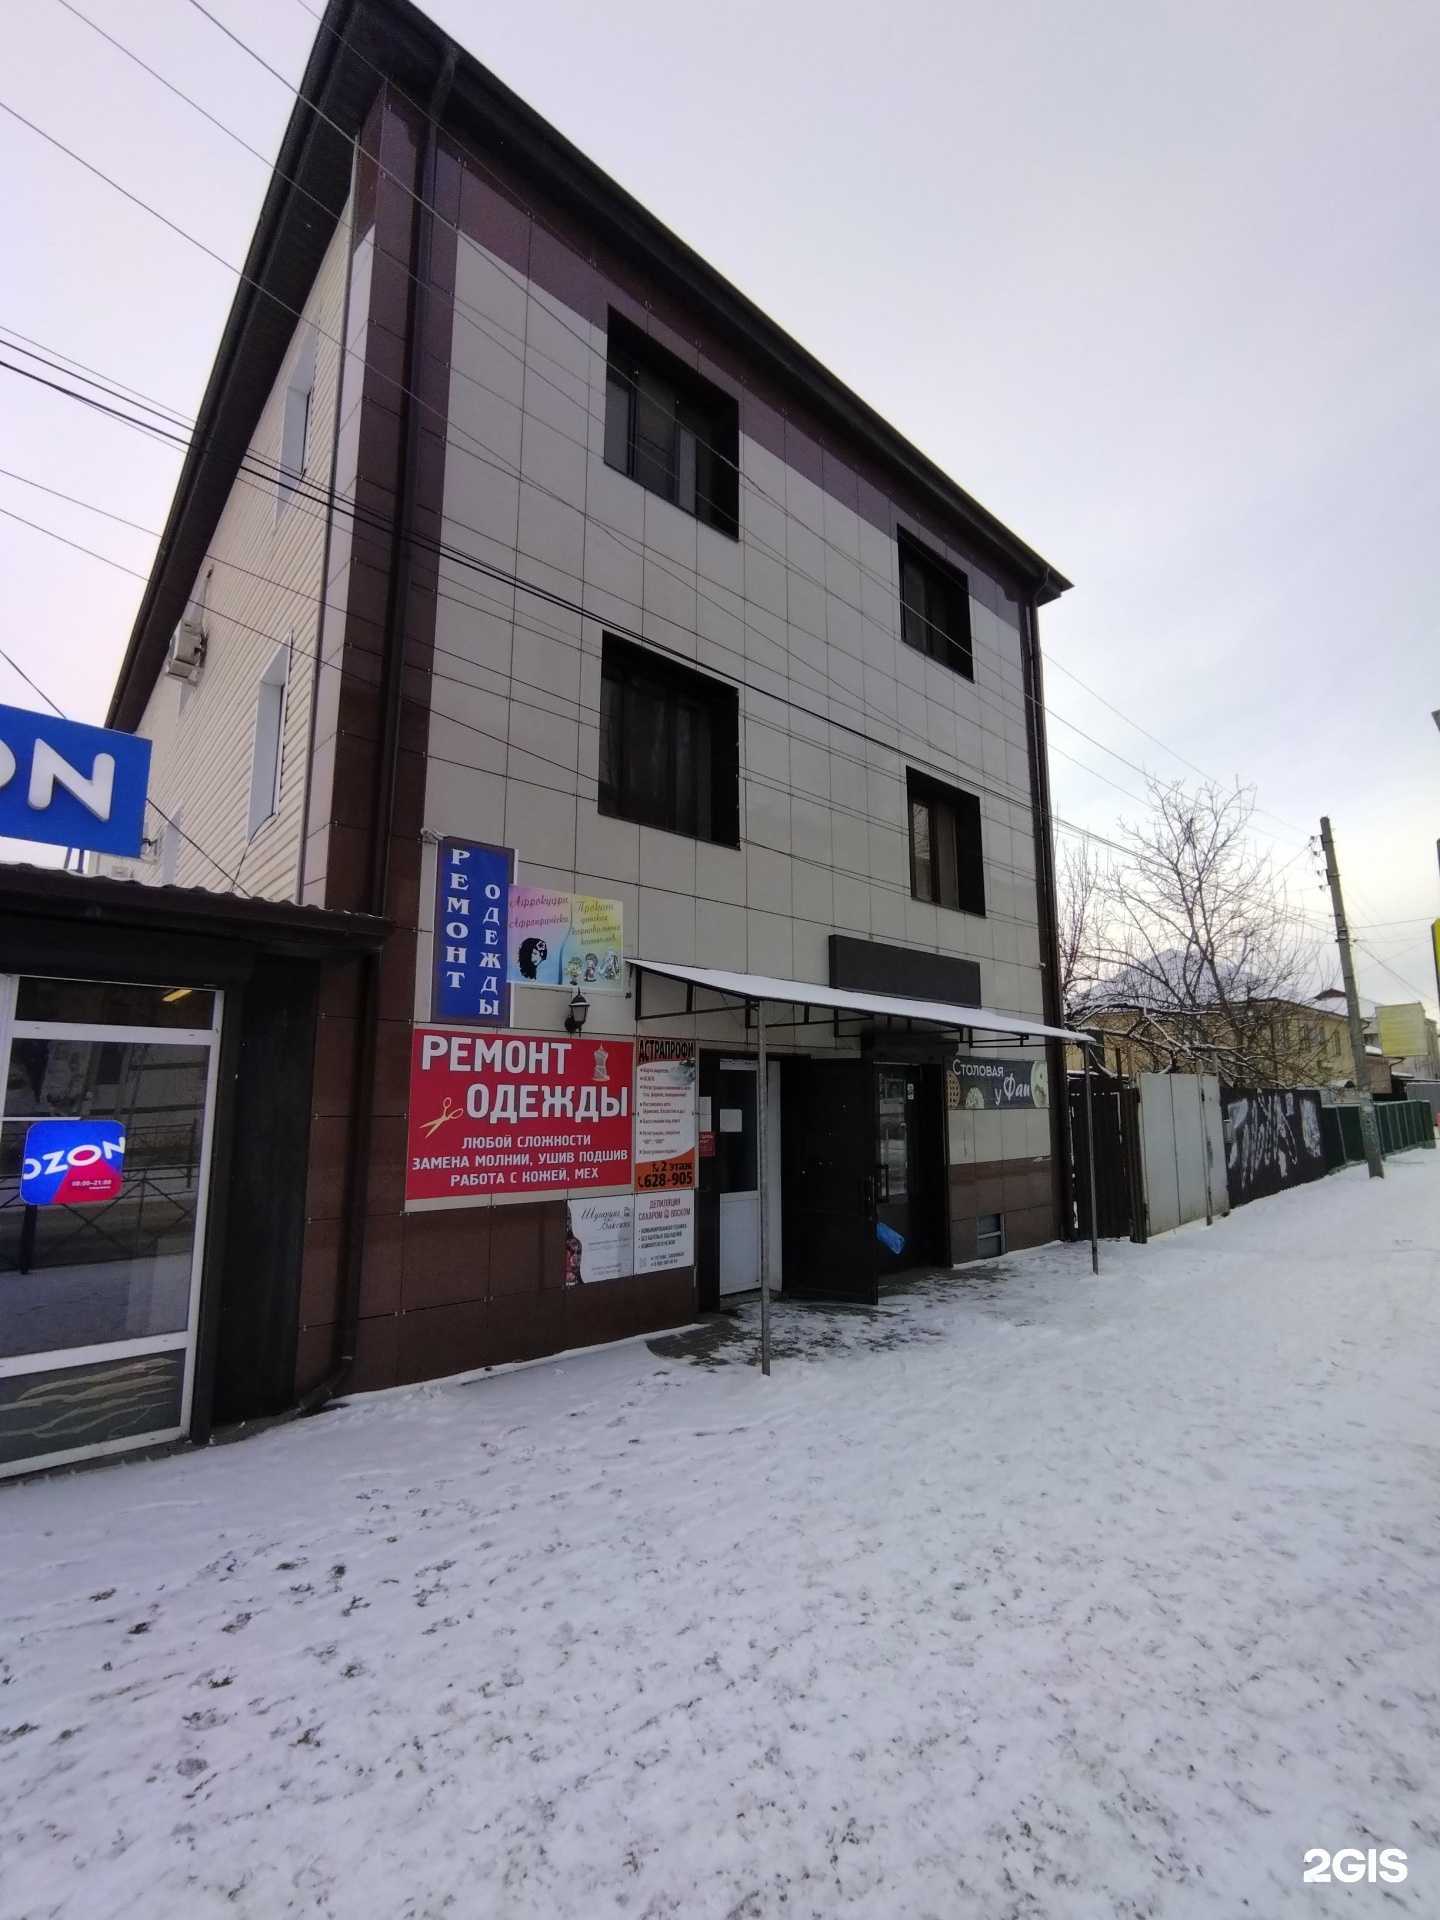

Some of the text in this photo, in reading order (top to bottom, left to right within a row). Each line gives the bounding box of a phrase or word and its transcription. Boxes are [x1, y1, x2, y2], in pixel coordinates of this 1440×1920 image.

[0, 737, 115, 822] N
[446, 848, 470, 988] РЕМОНТ
[479, 884, 501, 1016] ОДЕЖДЫ
[421, 1035, 572, 1075] РЕМОНТ
[466, 1083, 628, 1124] ОДЕЖДЫ
[994, 1087, 1002, 1105] у
[461, 1134, 591, 1149] ЛЮБОЙ СЛОЖНОСТИ
[23, 1136, 126, 1180] OZON
[412, 1156, 470, 1170] ЗАМЕНА
[475, 1153, 533, 1167] МОЛНИИ,
[538, 1151, 574, 1165] УШИВ
[579, 1149, 628, 1163] ПОДШИВ
[661, 1161, 692, 1172] 2 этаж
[450, 1167, 599, 1187] РАБОТА С КОЖЕЙ, МЕХ
[644, 1172, 693, 1187] 628-905
